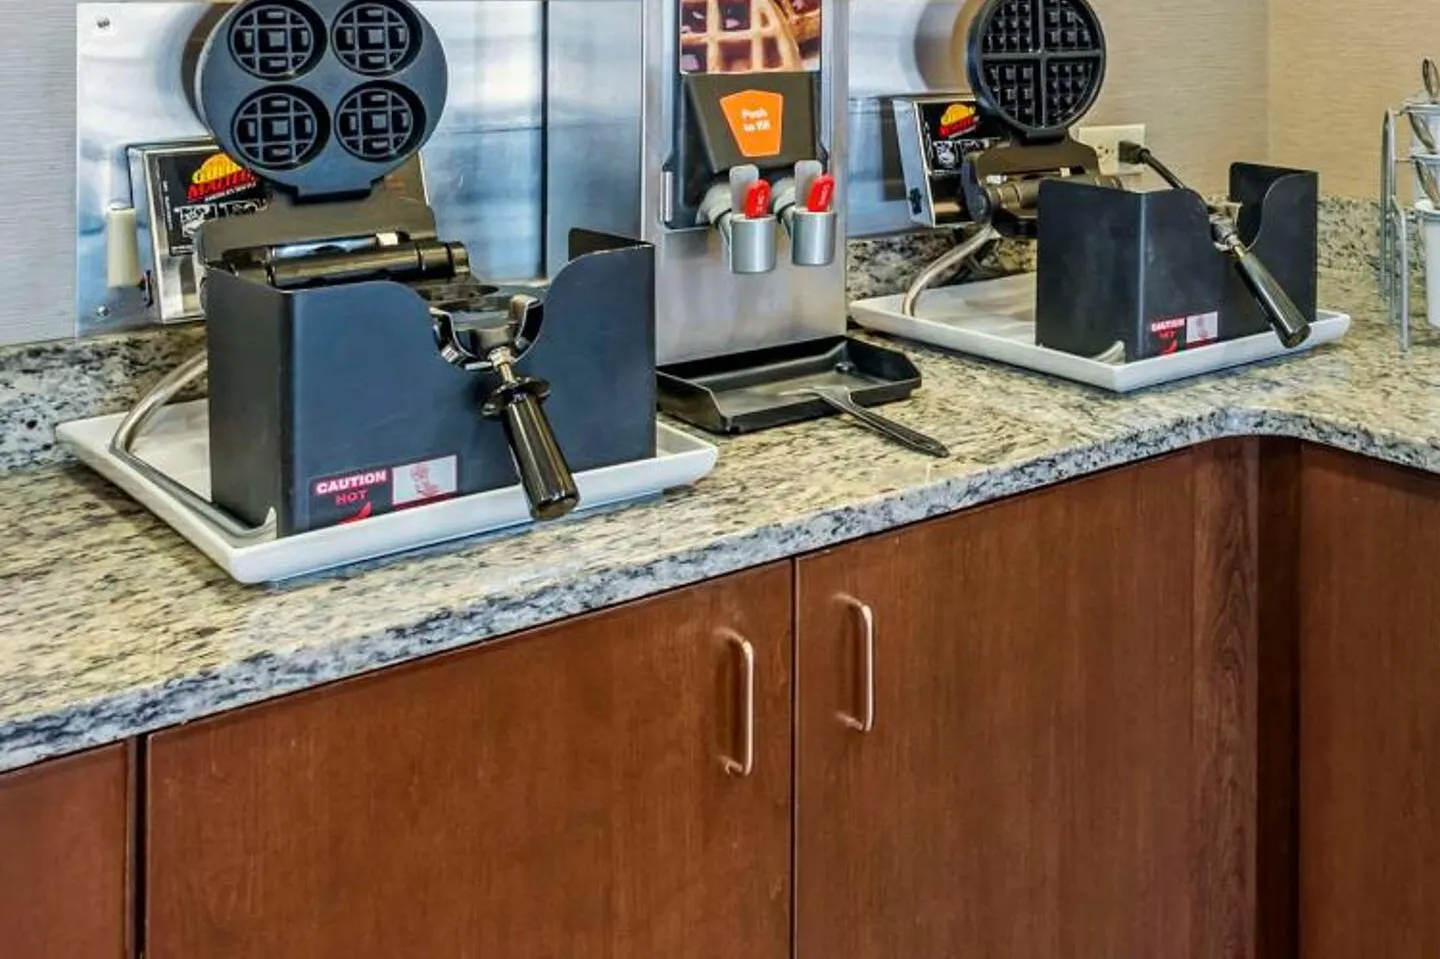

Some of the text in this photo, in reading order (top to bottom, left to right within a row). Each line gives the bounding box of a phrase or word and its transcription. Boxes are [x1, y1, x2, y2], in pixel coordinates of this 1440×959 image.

[741, 107, 769, 120] Push
[316, 469, 388, 495] CAUTION
[335, 490, 369, 506] HOT
